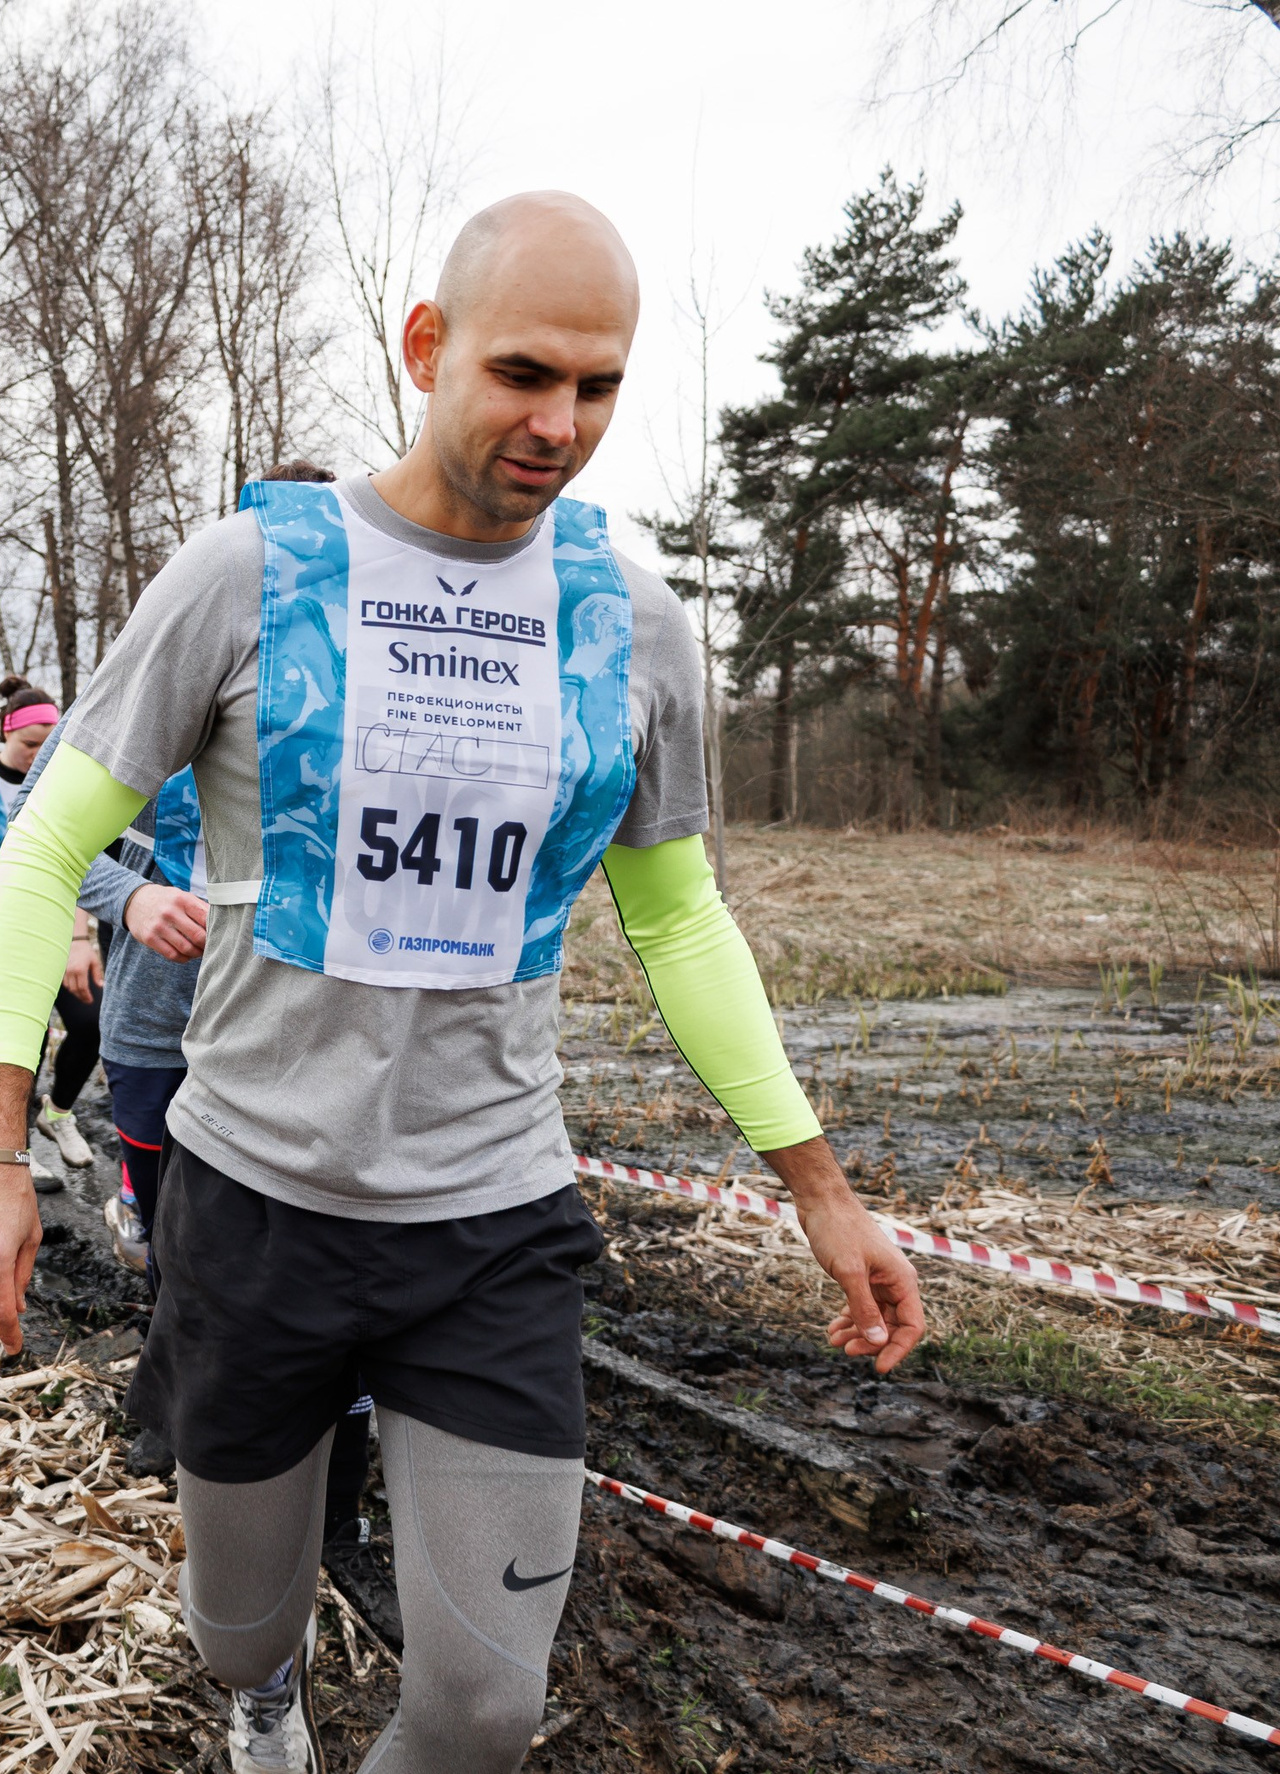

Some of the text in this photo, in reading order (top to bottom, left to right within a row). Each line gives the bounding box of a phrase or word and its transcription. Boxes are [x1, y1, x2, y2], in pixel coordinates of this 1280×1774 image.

[361, 600, 546, 638] ГОНКА ГЕРОЕВ
[388, 641, 521, 686] Sminex
[387, 691, 523, 716] ПЕРФЕКЦИОНИСТЫ
[387, 709, 523, 732] FINE DEVELOPMENT
[362, 722, 493, 776] СТАС
[356, 806, 528, 892] 5410
[399, 936, 495, 957] ГАЗПРОМБАНК
[201, 1113, 235, 1137] DRI-FIT
